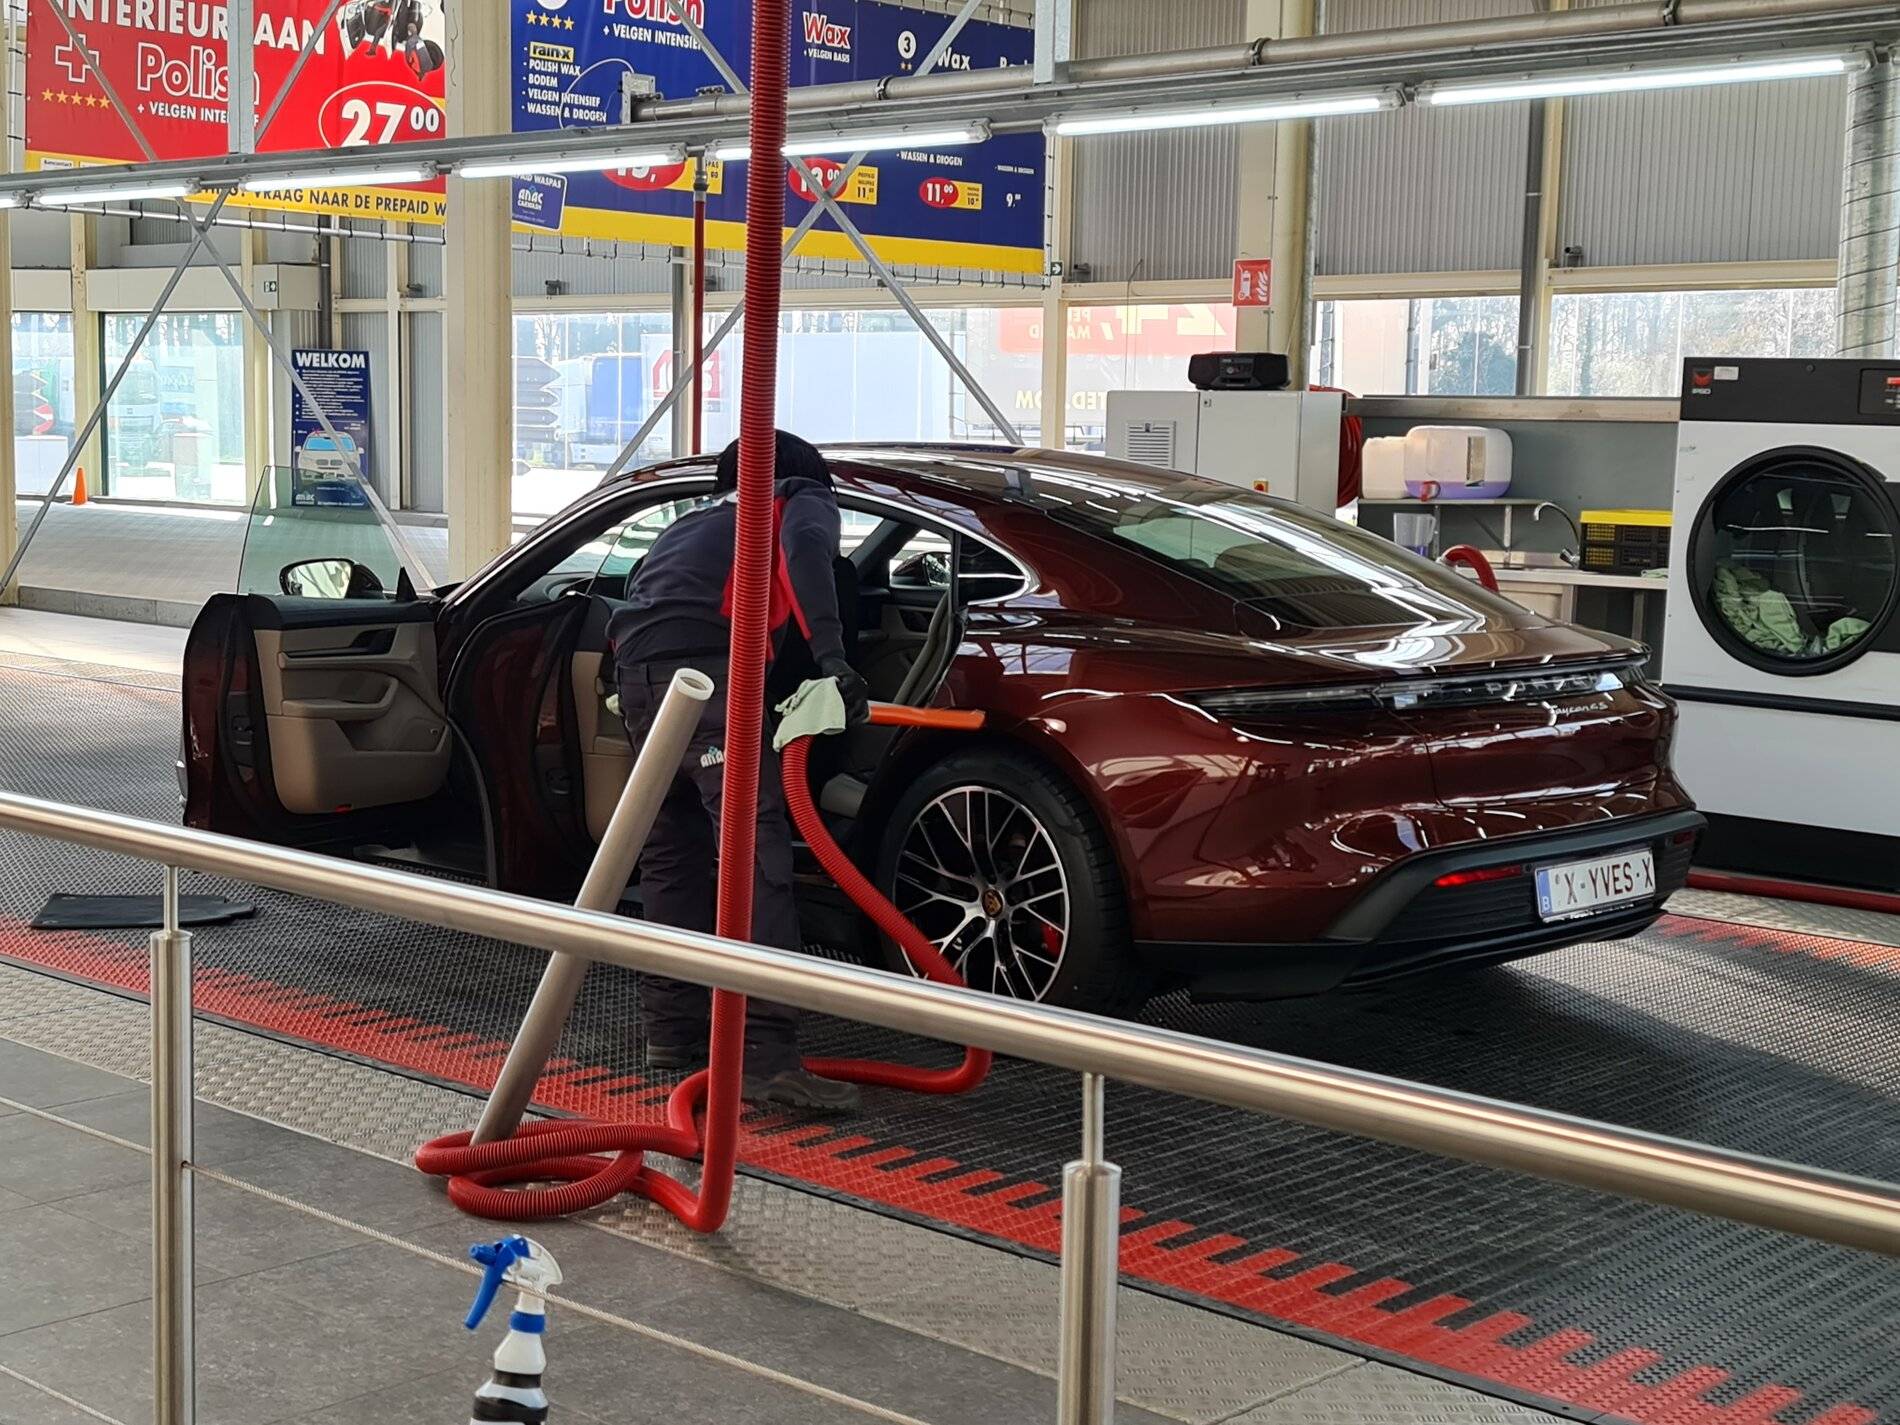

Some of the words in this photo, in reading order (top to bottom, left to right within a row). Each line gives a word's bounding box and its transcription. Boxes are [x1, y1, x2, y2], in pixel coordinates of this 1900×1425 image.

[54, 0, 229, 40] NTERIEUR
[253, 13, 325, 55] AAN
[803, 11, 851, 49] Wax
[613, 23, 651, 42] VELGEN
[655, 29, 702, 51] INTENSIE
[903, 36, 912, 53] 3
[808, 48, 833, 60] VELGEN
[529, 59, 559, 73] POLISH
[560, 63, 581, 76] WAX
[528, 73, 558, 88] BODEM
[528, 88, 560, 101] VELGEN
[561, 92, 600, 107] INTENSIEF
[149, 101, 197, 120] VELGEN
[200, 109, 260, 126] INTEF
[527, 102, 561, 117] WASSEN
[563, 107, 571, 119] &
[572, 107, 607, 123] DROGEN
[900, 151, 928, 163] WASSEN
[936, 155, 963, 167] DROGEN
[309, 190, 349, 208] NAAR
[354, 196, 371, 209] DE
[375, 199, 429, 215] PREPAID
[296, 352, 366, 369] WELKOM
[700, 750, 725, 768] ANA
